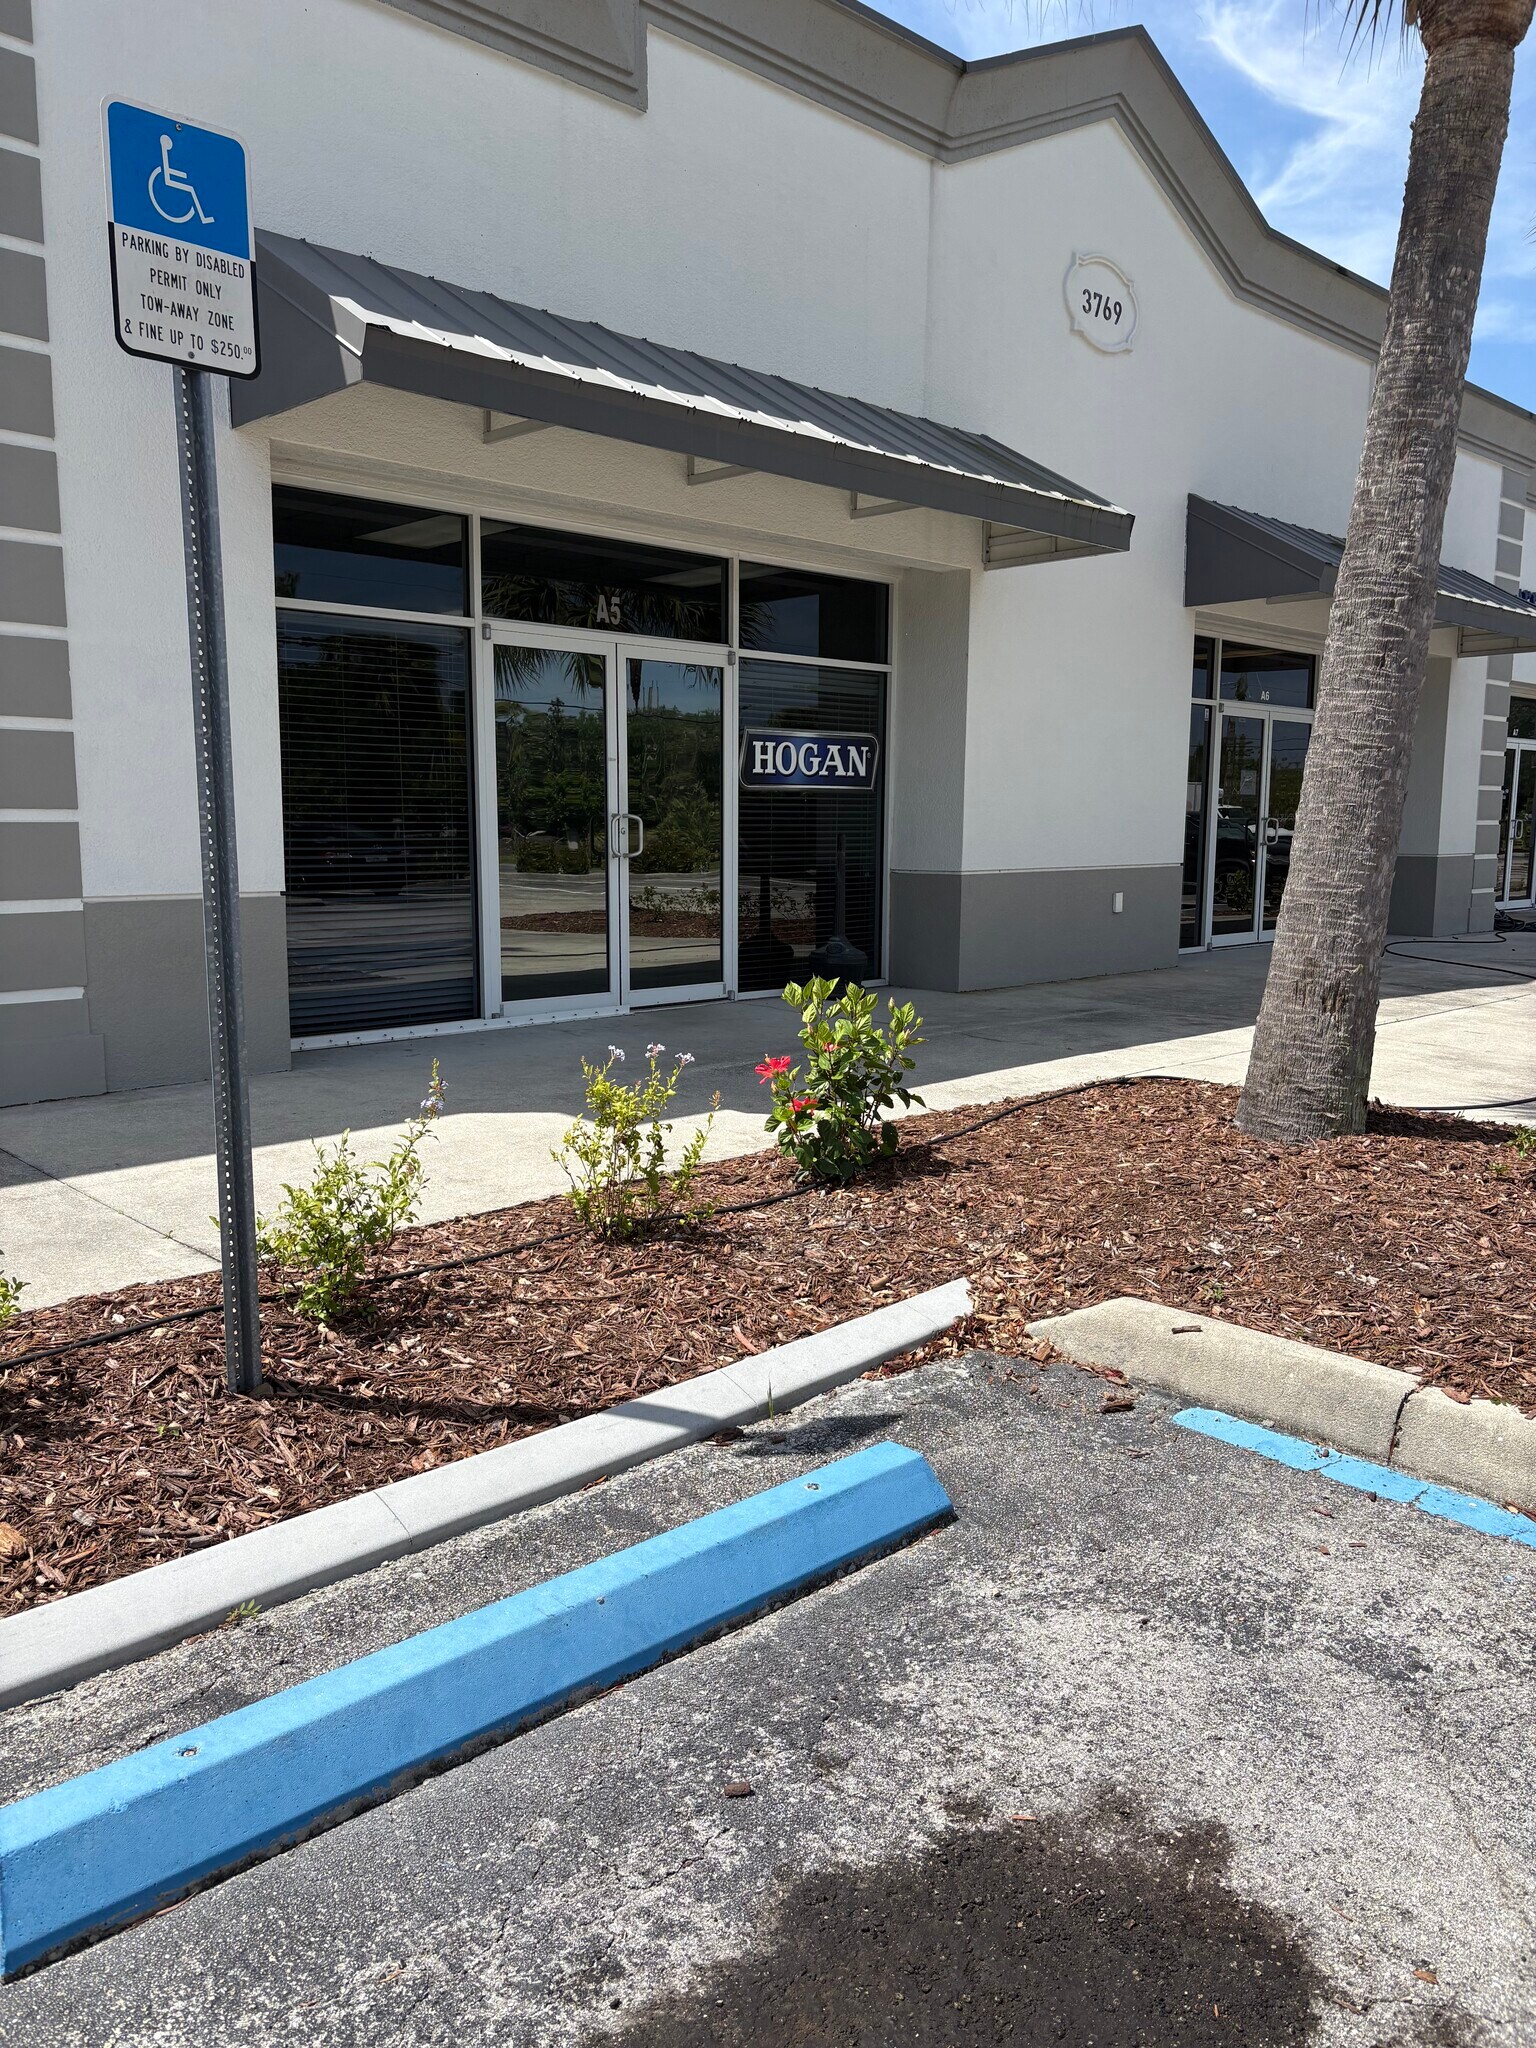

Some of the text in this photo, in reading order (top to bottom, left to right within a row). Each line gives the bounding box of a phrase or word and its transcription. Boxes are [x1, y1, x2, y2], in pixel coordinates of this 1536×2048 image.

[122, 232, 244, 278] PARKING BY DISABLED
[150, 268, 221, 300] PERMIT ONLY
[140, 293, 234, 331] TOW-AWAY ZONE
[1082, 288, 1123, 326] 3769
[124, 318, 132, 334] &
[139, 321, 164, 341] FINE
[170, 329, 184, 345] UP
[190, 333, 204, 351] TO
[596, 594, 621, 625] A5
[1260, 690, 1270, 701] A6
[752, 741, 869, 777] HOGAN
